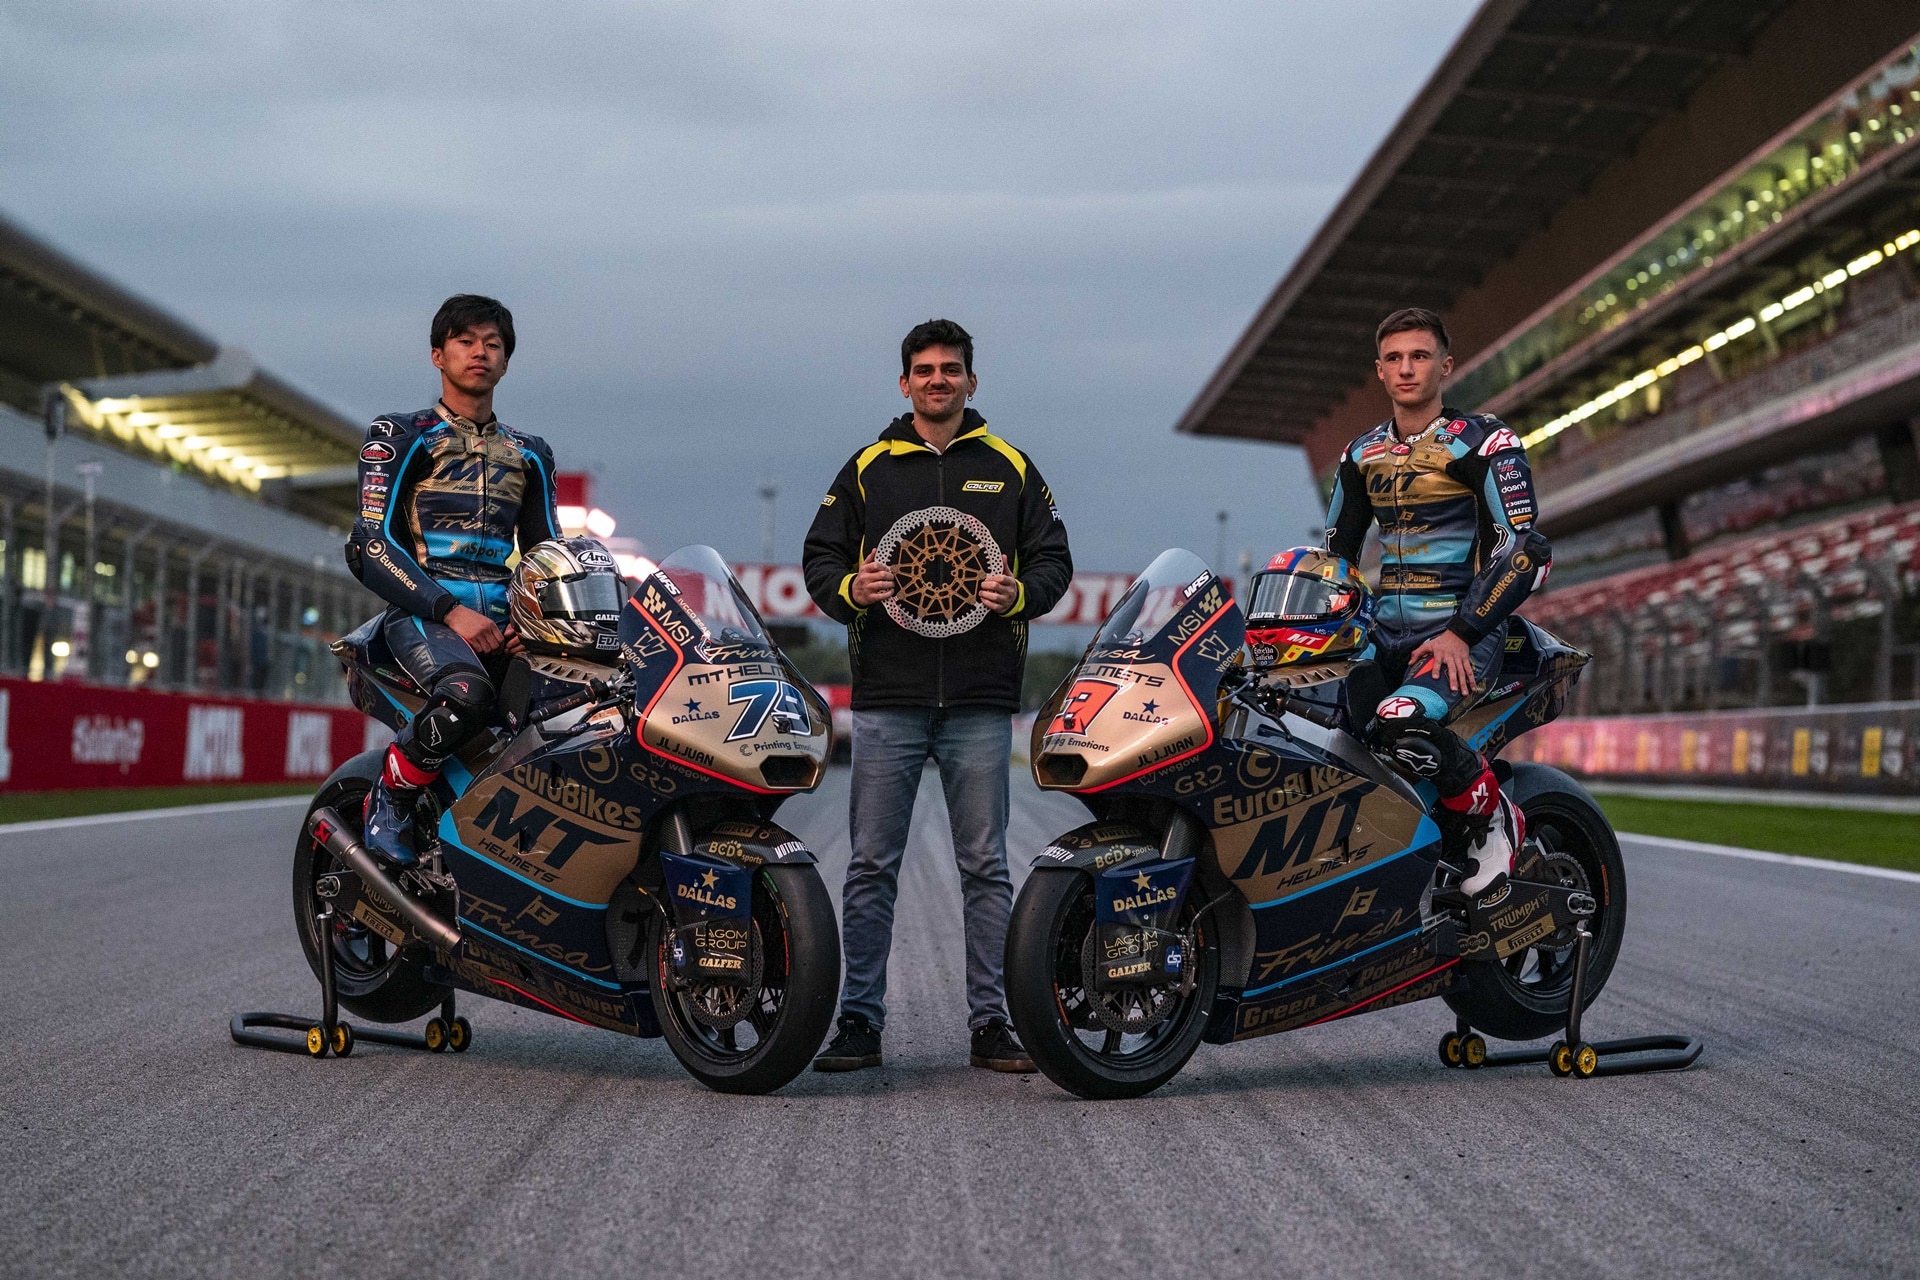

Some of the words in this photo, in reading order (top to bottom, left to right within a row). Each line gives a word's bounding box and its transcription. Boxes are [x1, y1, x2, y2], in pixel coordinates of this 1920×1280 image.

[433, 460, 523, 485] MT
[1369, 472, 1429, 494] MT
[966, 483, 999, 491] GALFER
[1508, 506, 1532, 516] GALFER
[379, 553, 418, 591] EuroBikes
[1408, 572, 1437, 583] Power
[1475, 569, 1517, 617] EuroBikes
[1167, 610, 1206, 646] MSi
[1287, 633, 1323, 646] MT
[620, 642, 648, 669] wegow
[688, 669, 724, 686] MT
[672, 710, 721, 725] DALLAS
[1123, 711, 1169, 725] DALLAS
[753, 740, 792, 752] Printing
[1067, 738, 1110, 752] Emotions
[669, 760, 710, 782] wegow
[1158, 755, 1200, 777] wegow
[472, 785, 631, 870] MT
[1229, 783, 1381, 881] MT
[478, 837, 562, 883] HELMETS
[708, 841, 736, 857] BCD
[742, 853, 763, 864] sports
[1095, 850, 1123, 868] BCD
[1131, 844, 1154, 857] sports
[1277, 843, 1374, 890] HELMETS
[677, 884, 737, 910] DALLAS
[1113, 886, 1177, 912] DALLAS
[363, 908, 394, 938] PIRELLI
[1490, 898, 1540, 932] TRIUMPH
[695, 928, 748, 940] LAGOM
[695, 938, 747, 950] GROUP
[1104, 931, 1158, 948] LAGOM
[1508, 922, 1544, 950] PIRELLI
[698, 957, 742, 969] GALFER
[1108, 961, 1151, 978] GALFER
[1359, 944, 1429, 988] Power
[553, 980, 625, 1018] Power
[1243, 993, 1317, 1029] Green
